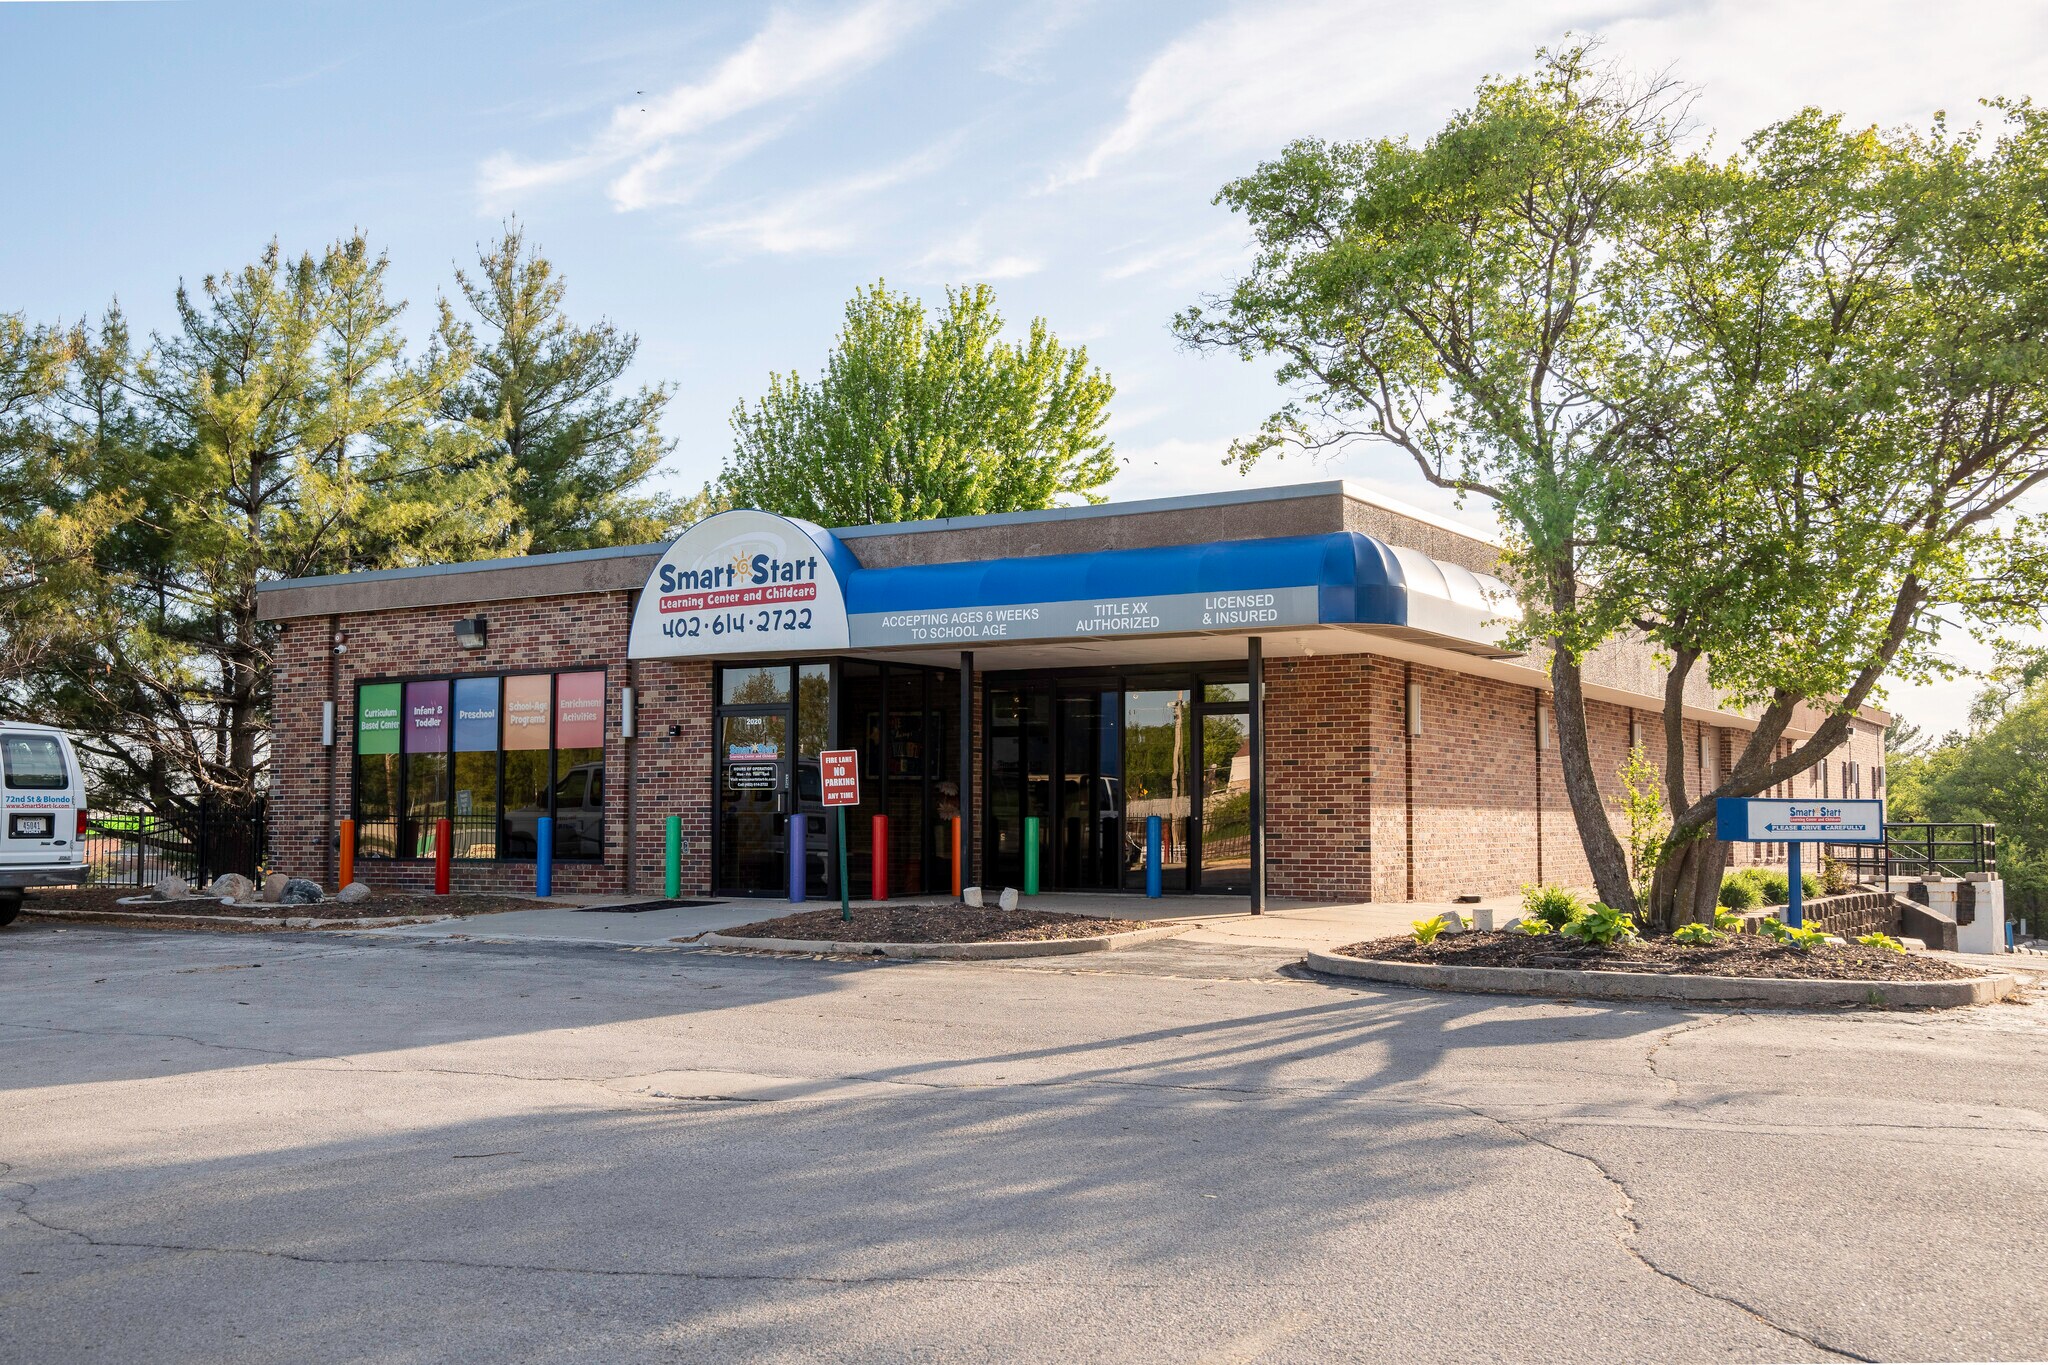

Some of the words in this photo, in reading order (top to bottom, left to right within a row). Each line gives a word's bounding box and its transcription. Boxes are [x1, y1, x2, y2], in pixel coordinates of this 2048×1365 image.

[660, 563, 735, 593] Smart
[751, 553, 817, 584] Start
[661, 596, 703, 609] Learning
[707, 593, 739, 605] Center
[743, 590, 761, 601] and
[766, 586, 814, 600] Childcare
[1205, 594, 1274, 610] LICENSED
[1094, 604, 1129, 617] TITLE
[1131, 602, 1148, 615] XX
[882, 612, 949, 628] ACCEPTING
[951, 611, 983, 625] AGES
[986, 610, 993, 623] 6
[995, 608, 1039, 622] WEEKS
[1202, 613, 1212, 625] &
[1214, 610, 1277, 624] INSURED
[1076, 616, 1160, 632] AUTHORIZED
[911, 627, 928, 640] TO
[930, 625, 974, 639] SCHOOL
[977, 624, 1007, 637] AGE
[508, 701, 548, 713] School-Age
[560, 698, 602, 708] Enrichment
[364, 708, 397, 718] Curriculum
[414, 706, 435, 715] Infant
[437, 705, 443, 714] &
[459, 709, 495, 719] Preschool
[415, 718, 442, 727] Toddler
[510, 715, 546, 727] Programs
[562, 712, 597, 722] Activities
[361, 722, 379, 730] Based
[380, 720, 400, 730] Center
[833, 766, 845, 777] NO
[825, 777, 855, 787] PARKING
[43, 795, 70, 803] Blondo
[1789, 807, 1815, 817] Smart
[1820, 806, 1841, 816] Start
[23, 821, 40, 830] 45041
